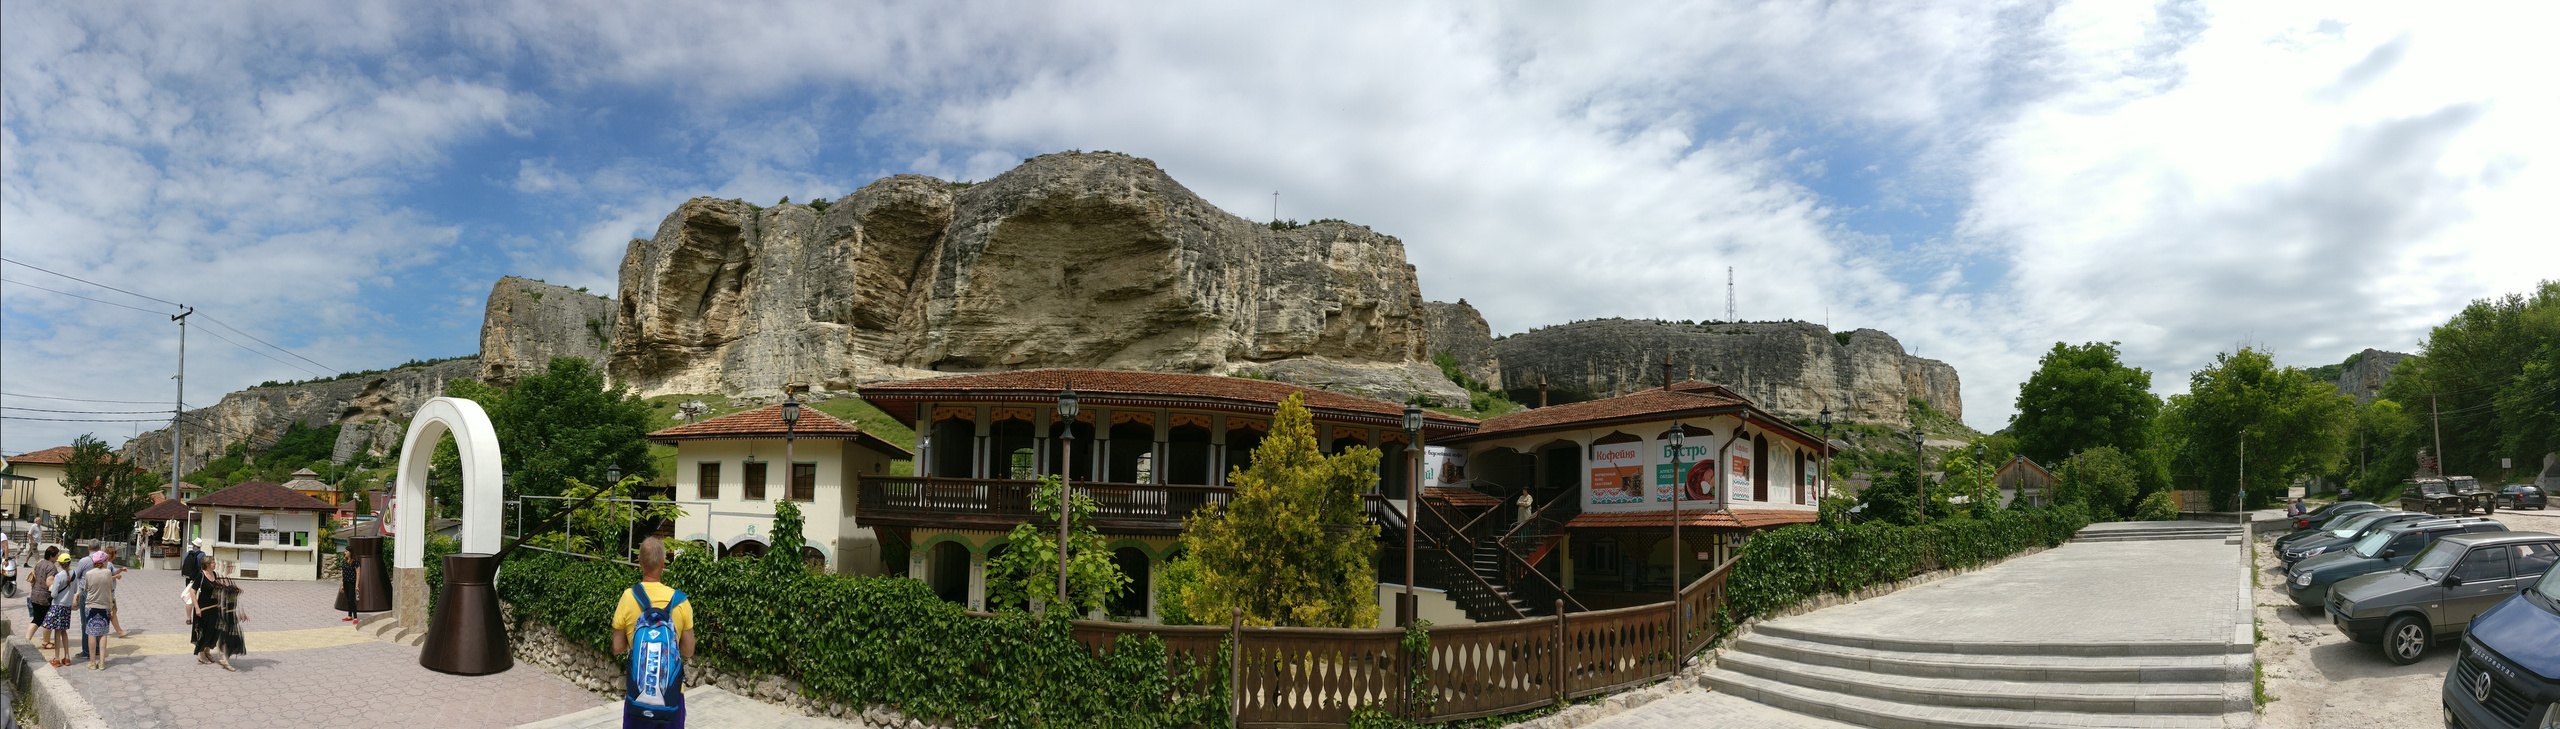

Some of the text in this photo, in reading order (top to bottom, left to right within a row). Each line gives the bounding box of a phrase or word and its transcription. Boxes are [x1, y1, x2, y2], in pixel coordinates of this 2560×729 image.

[1597, 450, 1635, 463] Кофейня
[1664, 445, 1707, 460] Бстро
[645, 650, 660, 697] SOCHI
[2471, 646, 2516, 678] TRANSPORTER
